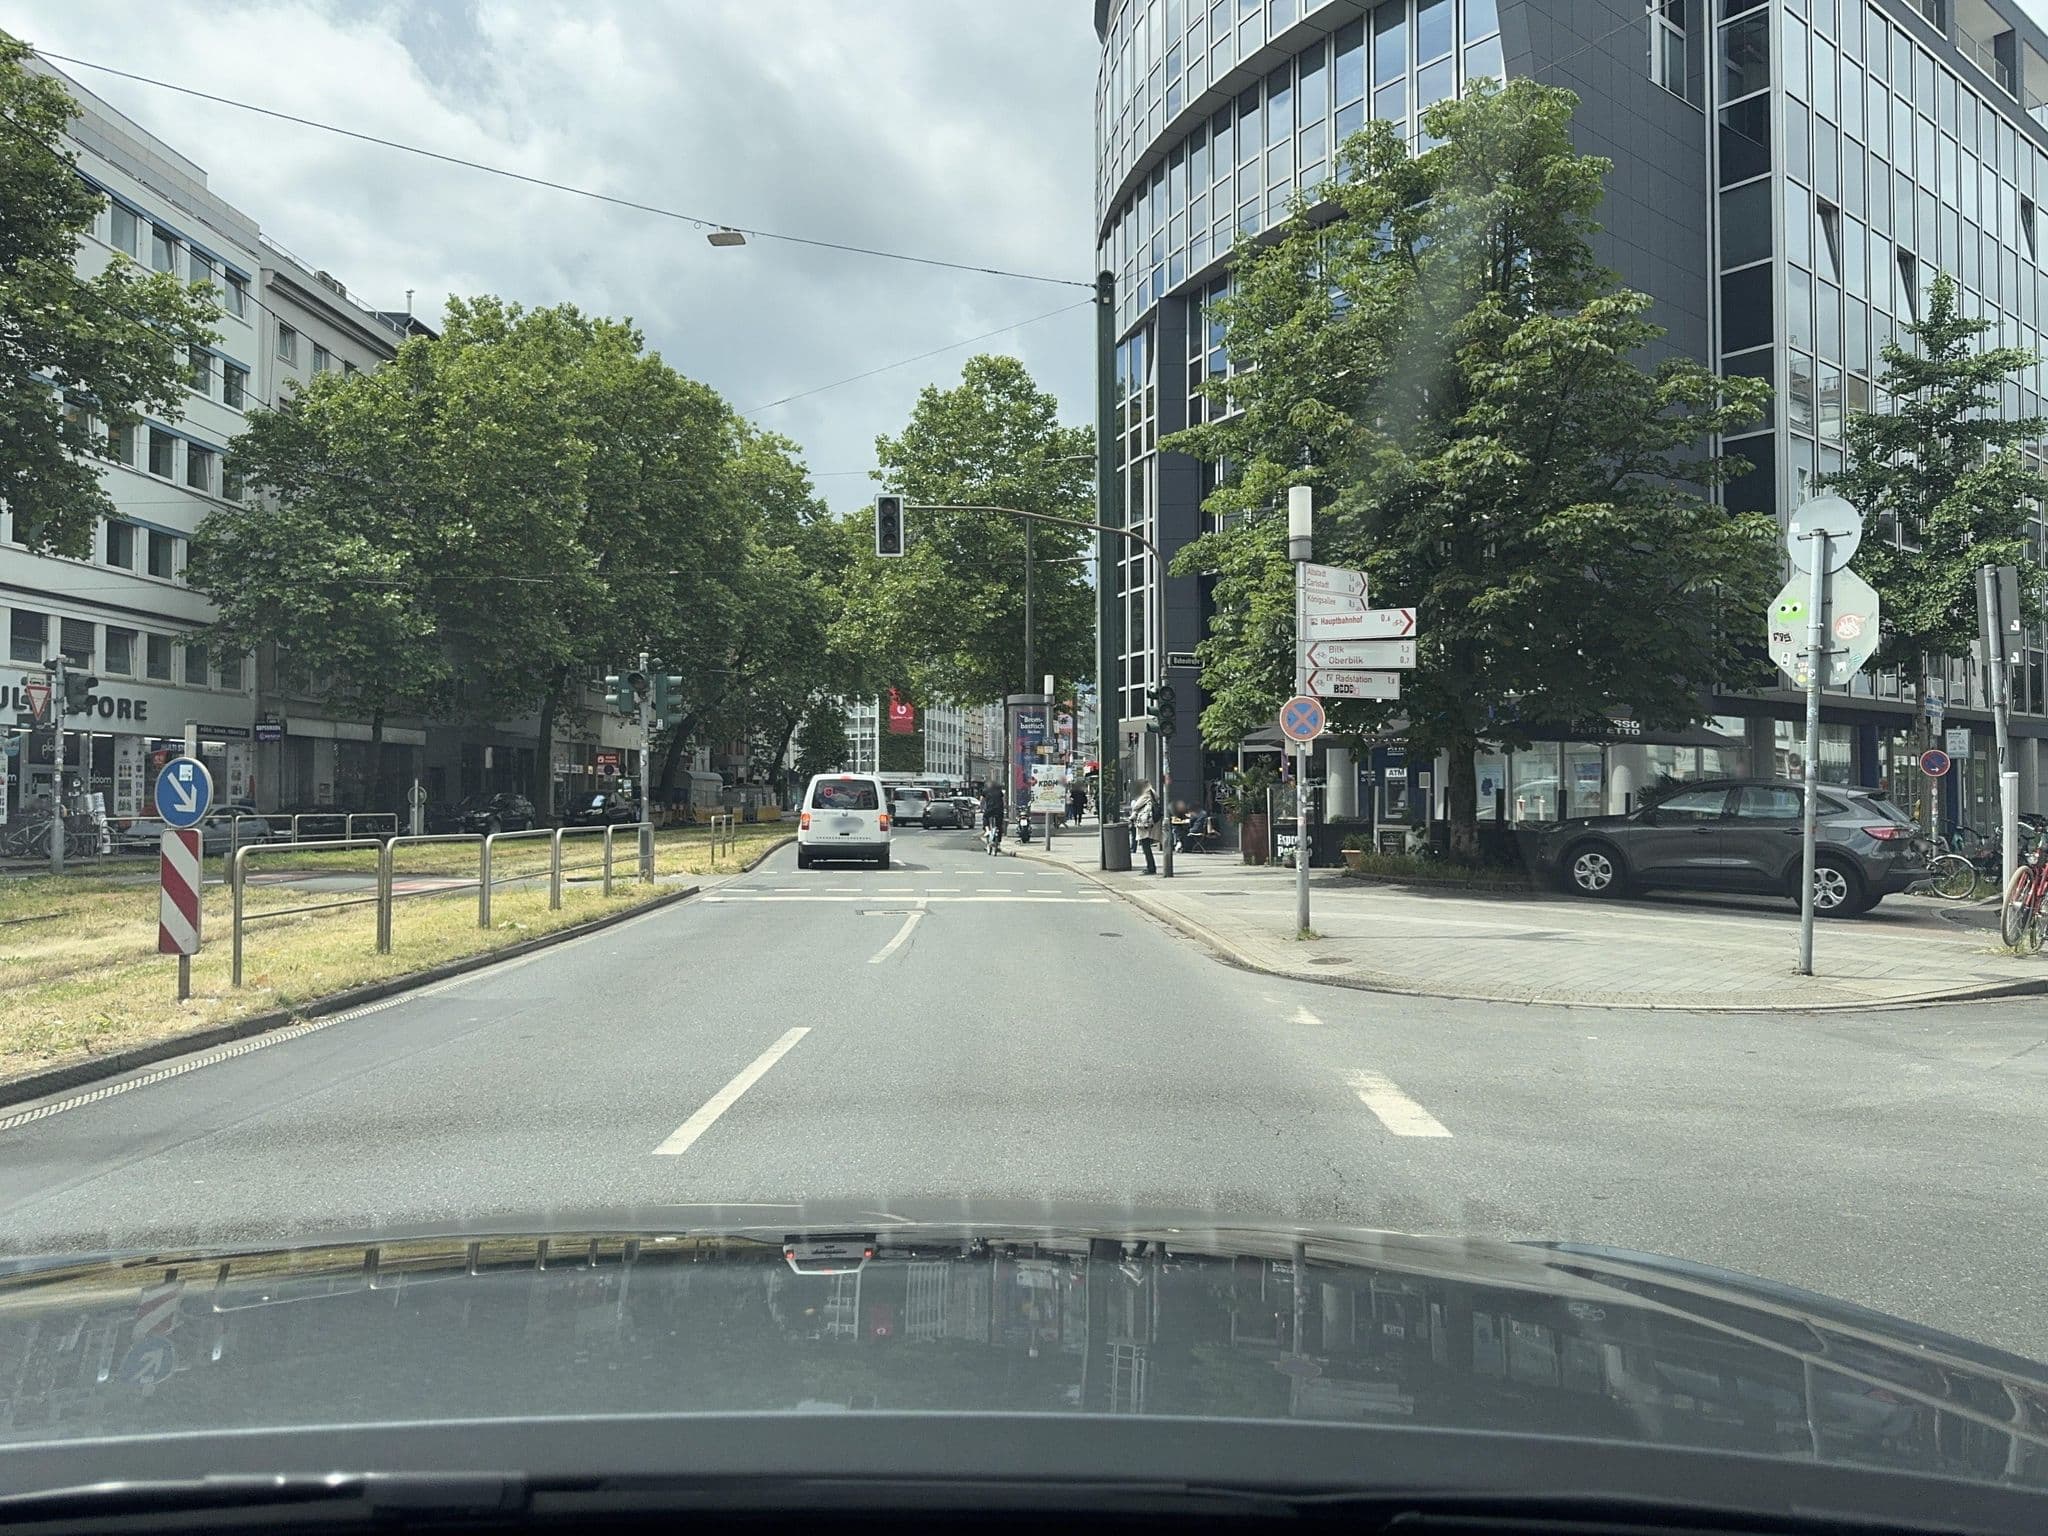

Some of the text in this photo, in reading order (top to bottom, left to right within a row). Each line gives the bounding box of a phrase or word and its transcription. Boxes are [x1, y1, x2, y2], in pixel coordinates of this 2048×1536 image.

[1320, 615, 1363, 626] Hauptbahnhof
[1328, 645, 1345, 654] Bilk
[1328, 656, 1364, 665] Oberbilk
[1336, 674, 1373, 684] Radstation
[1388, 769, 1405, 777] ATM
